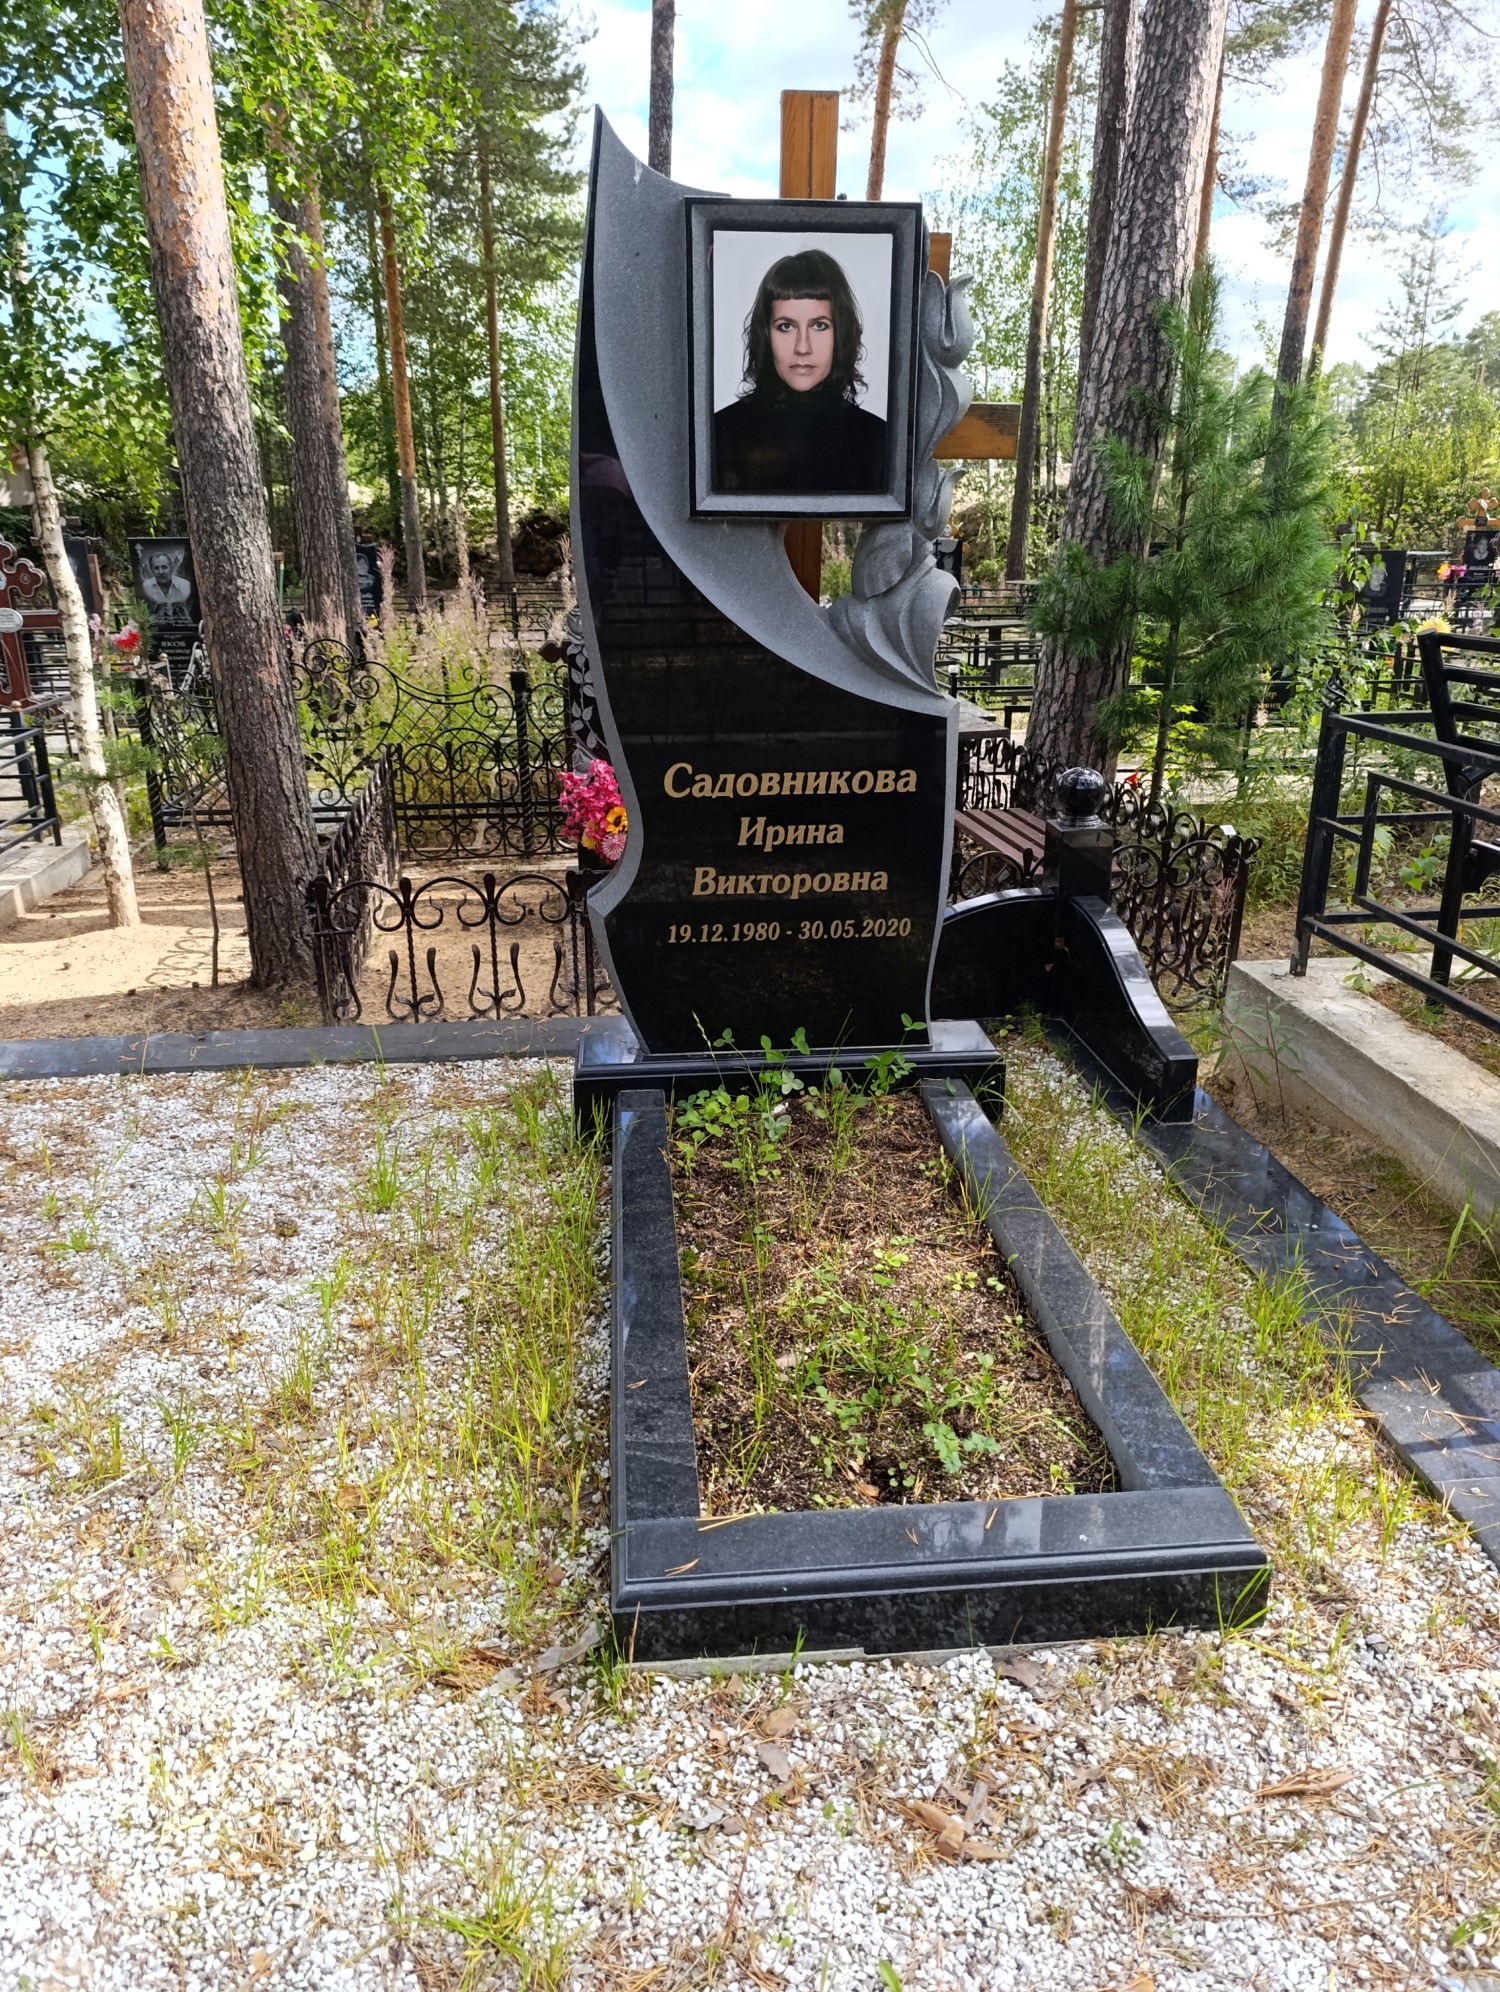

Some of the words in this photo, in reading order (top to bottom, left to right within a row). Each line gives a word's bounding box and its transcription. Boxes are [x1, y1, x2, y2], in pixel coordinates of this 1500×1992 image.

[664, 762, 918, 799] Садовникова
[737, 816, 844, 852] Ирина
[692, 866, 889, 899] Викторовна
[667, 922, 781, 943] 19.12.1980
[798, 917, 912, 940] 30.05.2020
